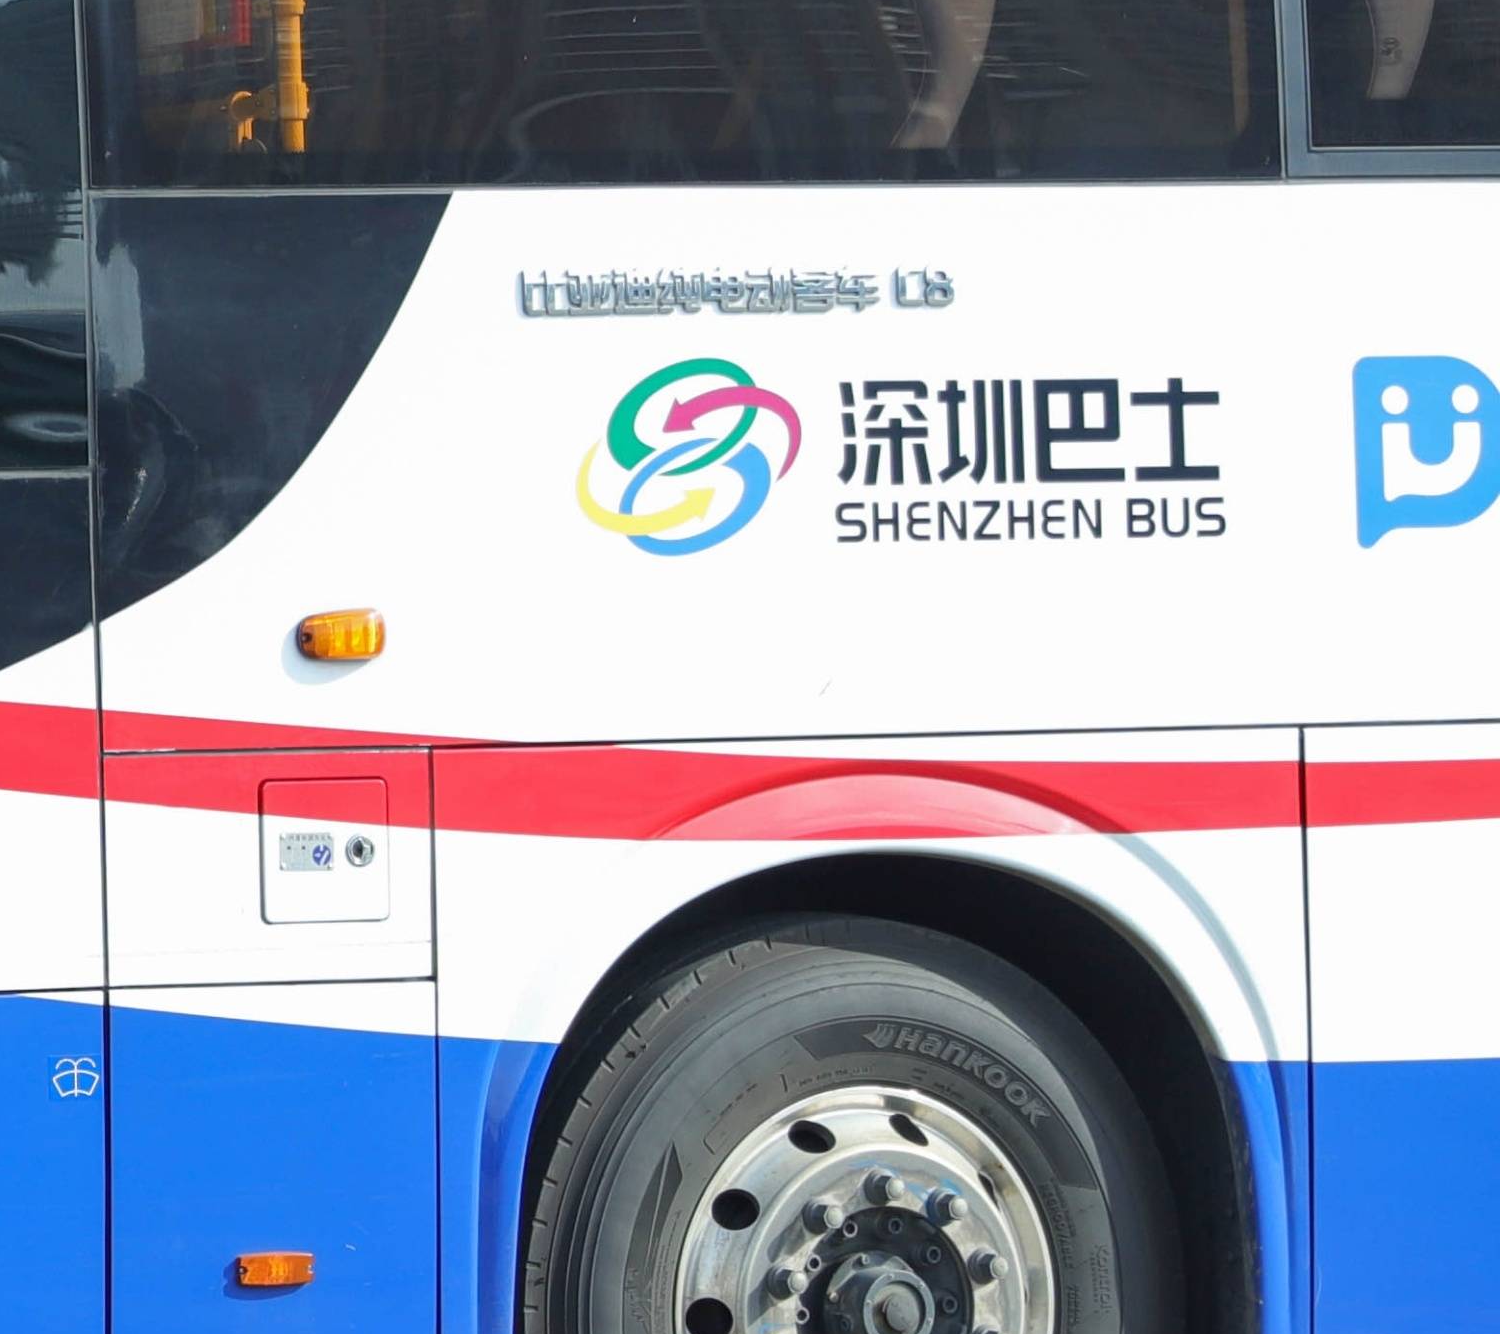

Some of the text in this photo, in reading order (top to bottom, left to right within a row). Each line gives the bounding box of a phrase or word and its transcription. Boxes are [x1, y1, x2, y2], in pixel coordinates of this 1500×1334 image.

[836, 377, 1221, 486] 深圳巴士
[835, 496, 1227, 543] SHENZHEN BUS
